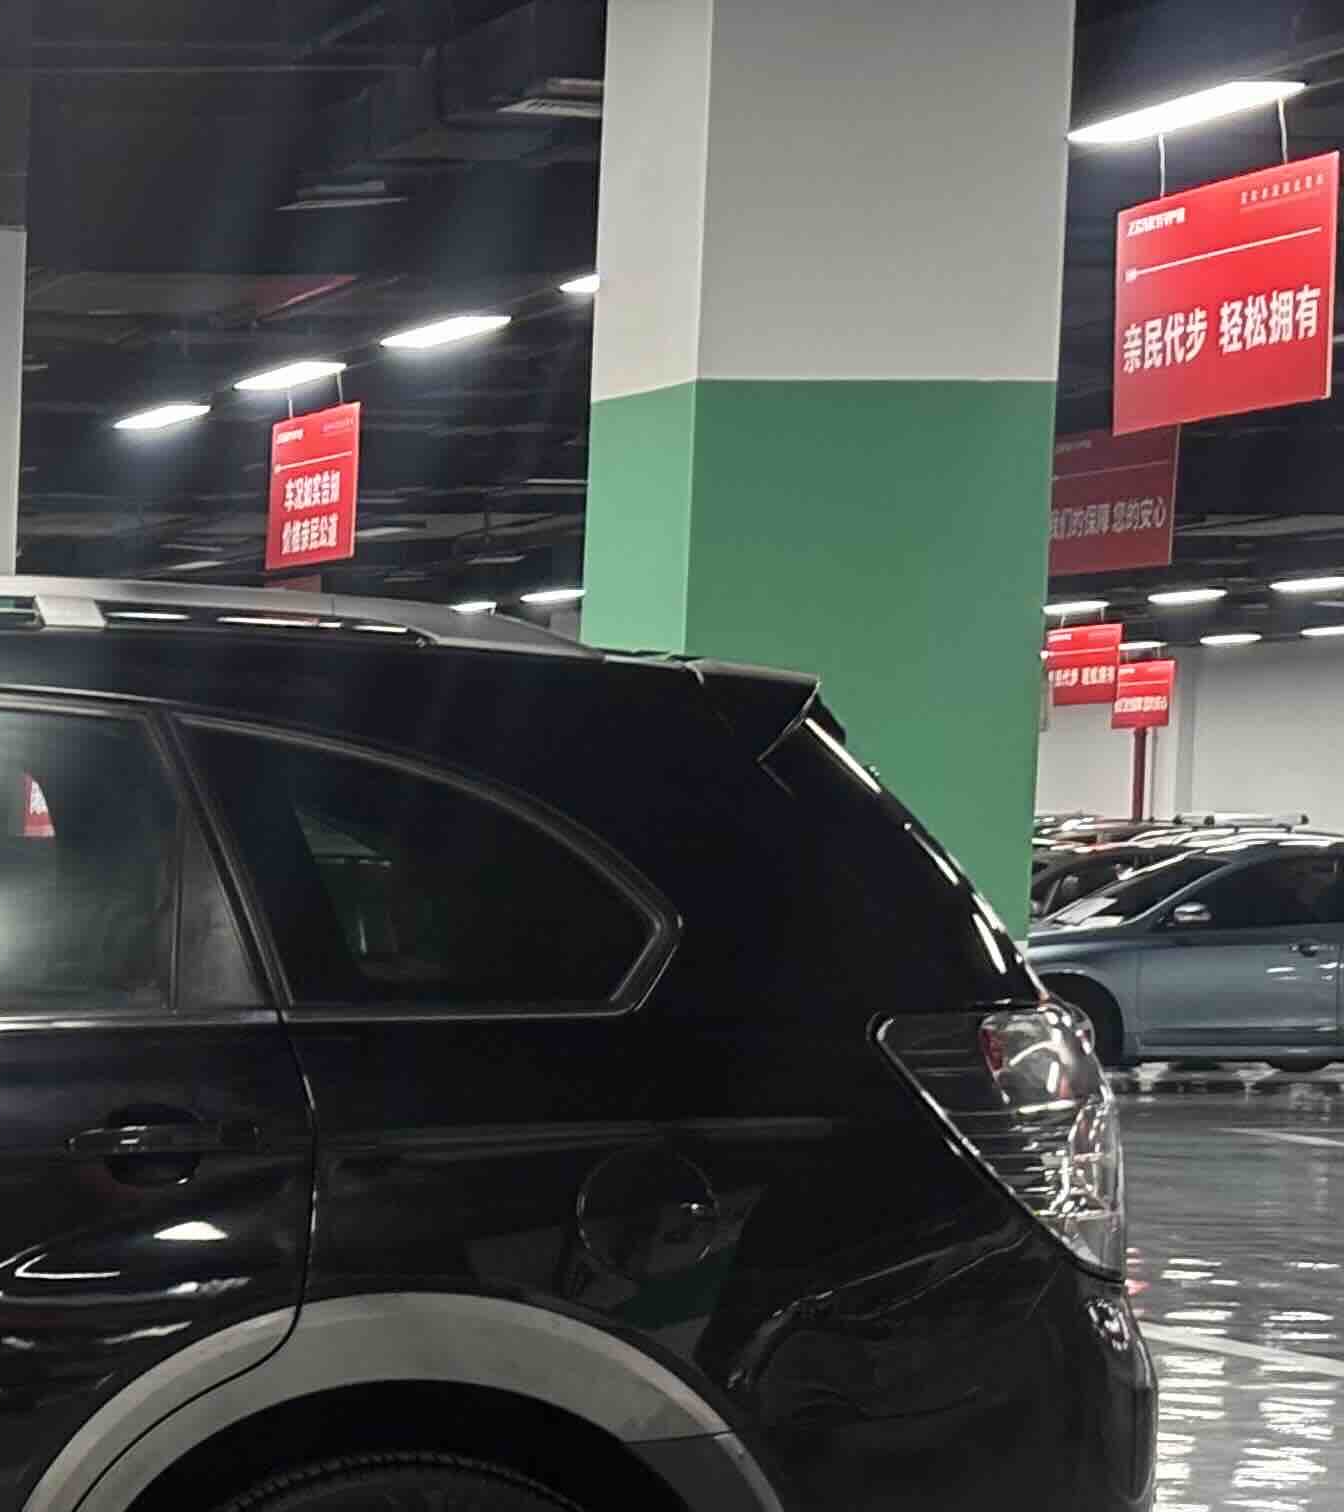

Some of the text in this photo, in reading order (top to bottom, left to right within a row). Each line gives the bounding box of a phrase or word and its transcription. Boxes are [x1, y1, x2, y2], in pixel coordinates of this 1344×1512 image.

[1123, 284, 1321, 374] 亲民代步 轻松拥有
[283, 469, 341, 512] 车况如实告知
